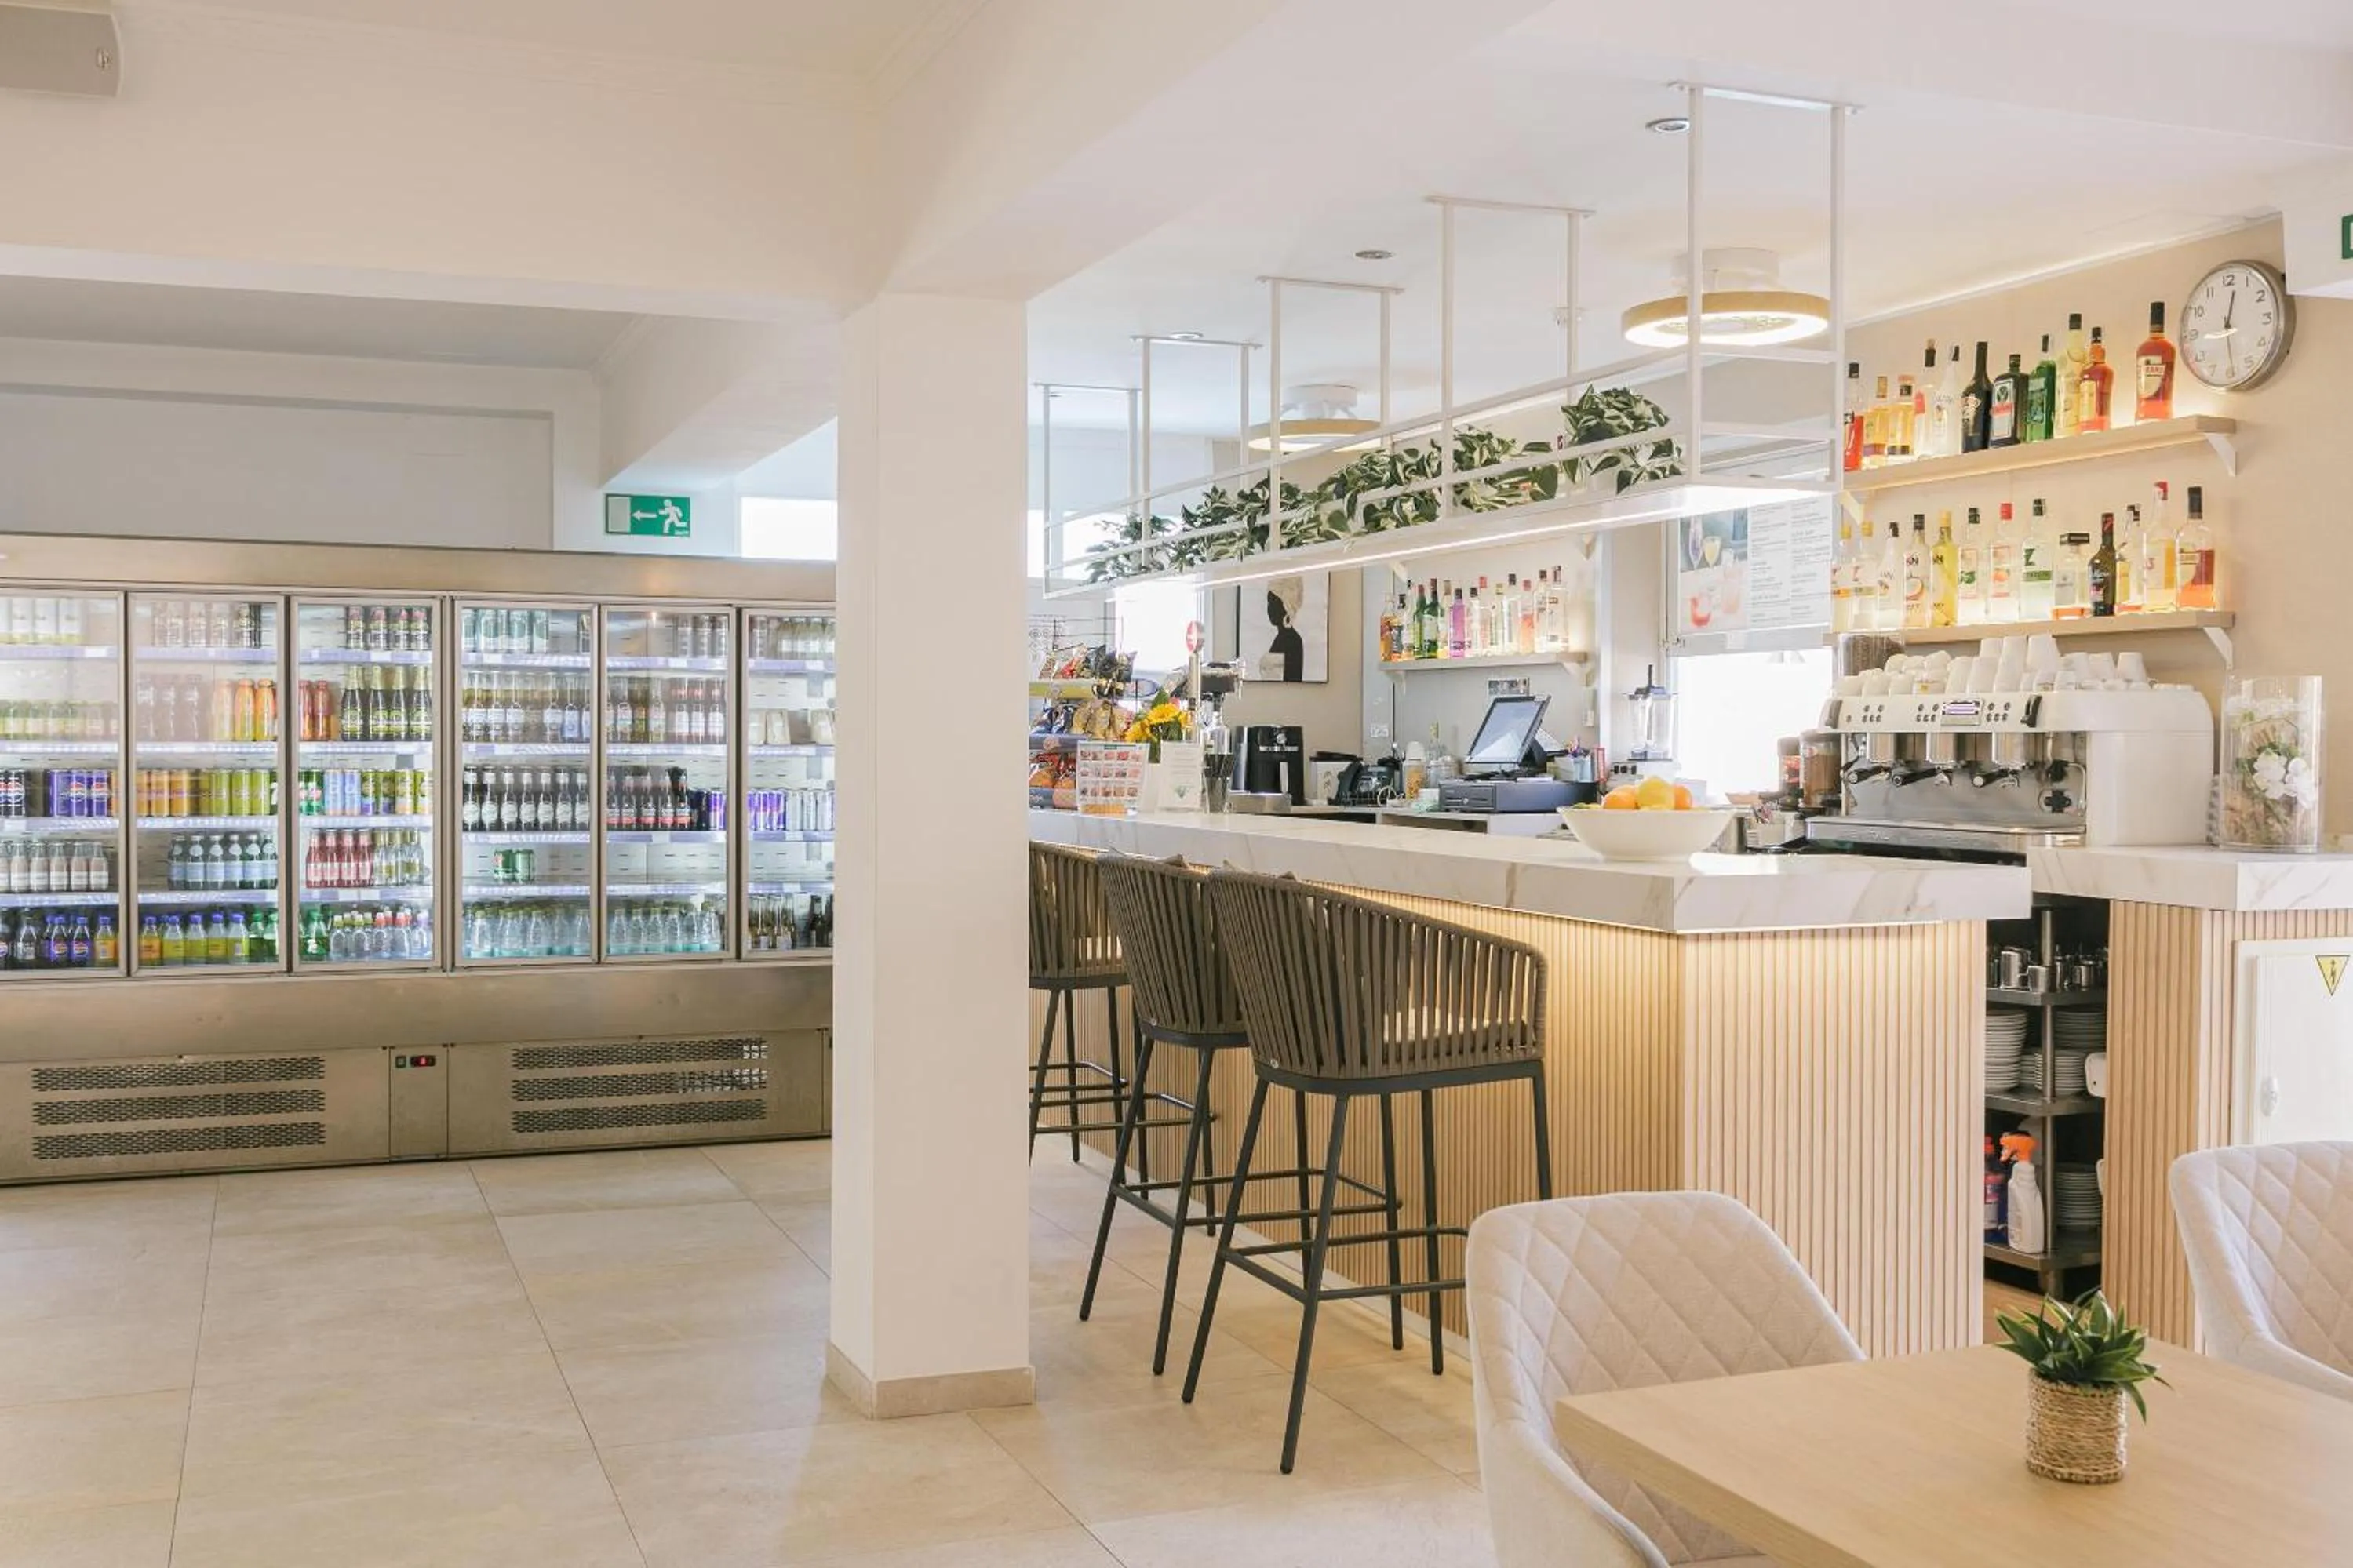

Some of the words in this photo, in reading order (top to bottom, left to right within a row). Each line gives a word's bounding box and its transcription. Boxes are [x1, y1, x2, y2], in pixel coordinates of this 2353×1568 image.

[2222, 274, 2235, 287] 12
[2246, 275, 2249, 288] 1
[2206, 287, 2214, 300] 11
[2256, 289, 2266, 303] 2
[2193, 306, 2205, 318] 10
[2261, 312, 2272, 326] 3
[2188, 329, 2199, 341] 9
[2256, 337, 2267, 347] 4
[2244, 355, 2255, 369] 5
[2208, 365, 2217, 377] 7
